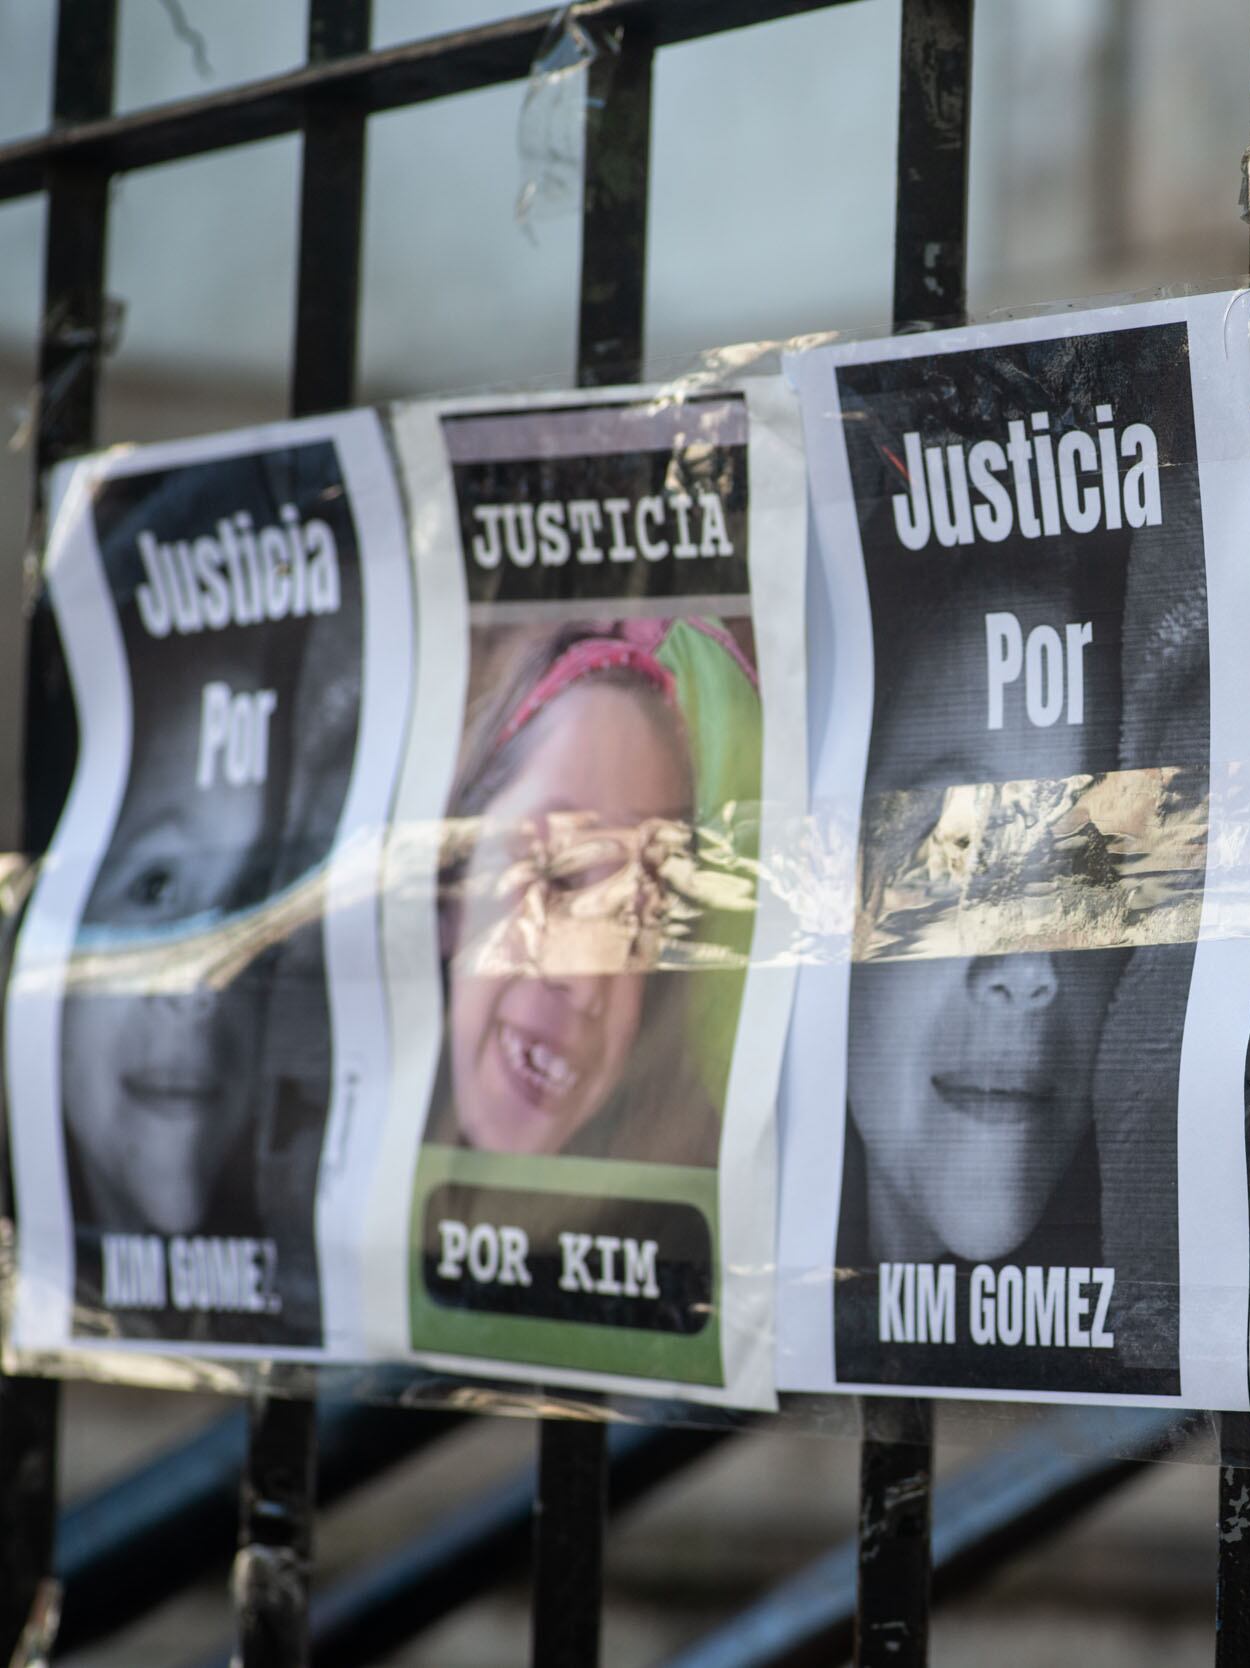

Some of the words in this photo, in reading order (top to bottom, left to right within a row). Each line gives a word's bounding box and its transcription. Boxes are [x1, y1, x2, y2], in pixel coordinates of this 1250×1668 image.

[892, 404, 1164, 551] Justicia
[135, 502, 341, 637] Justicia
[472, 493, 733, 568] JUSTICIA
[984, 612, 1093, 730] Por
[198, 682, 275, 789] Por
[102, 1234, 167, 1310] KIM
[438, 1220, 531, 1285] POR
[558, 1232, 660, 1298] KIM
[878, 1263, 956, 1345] KIM
[969, 1266, 1116, 1349] GOMEZ
